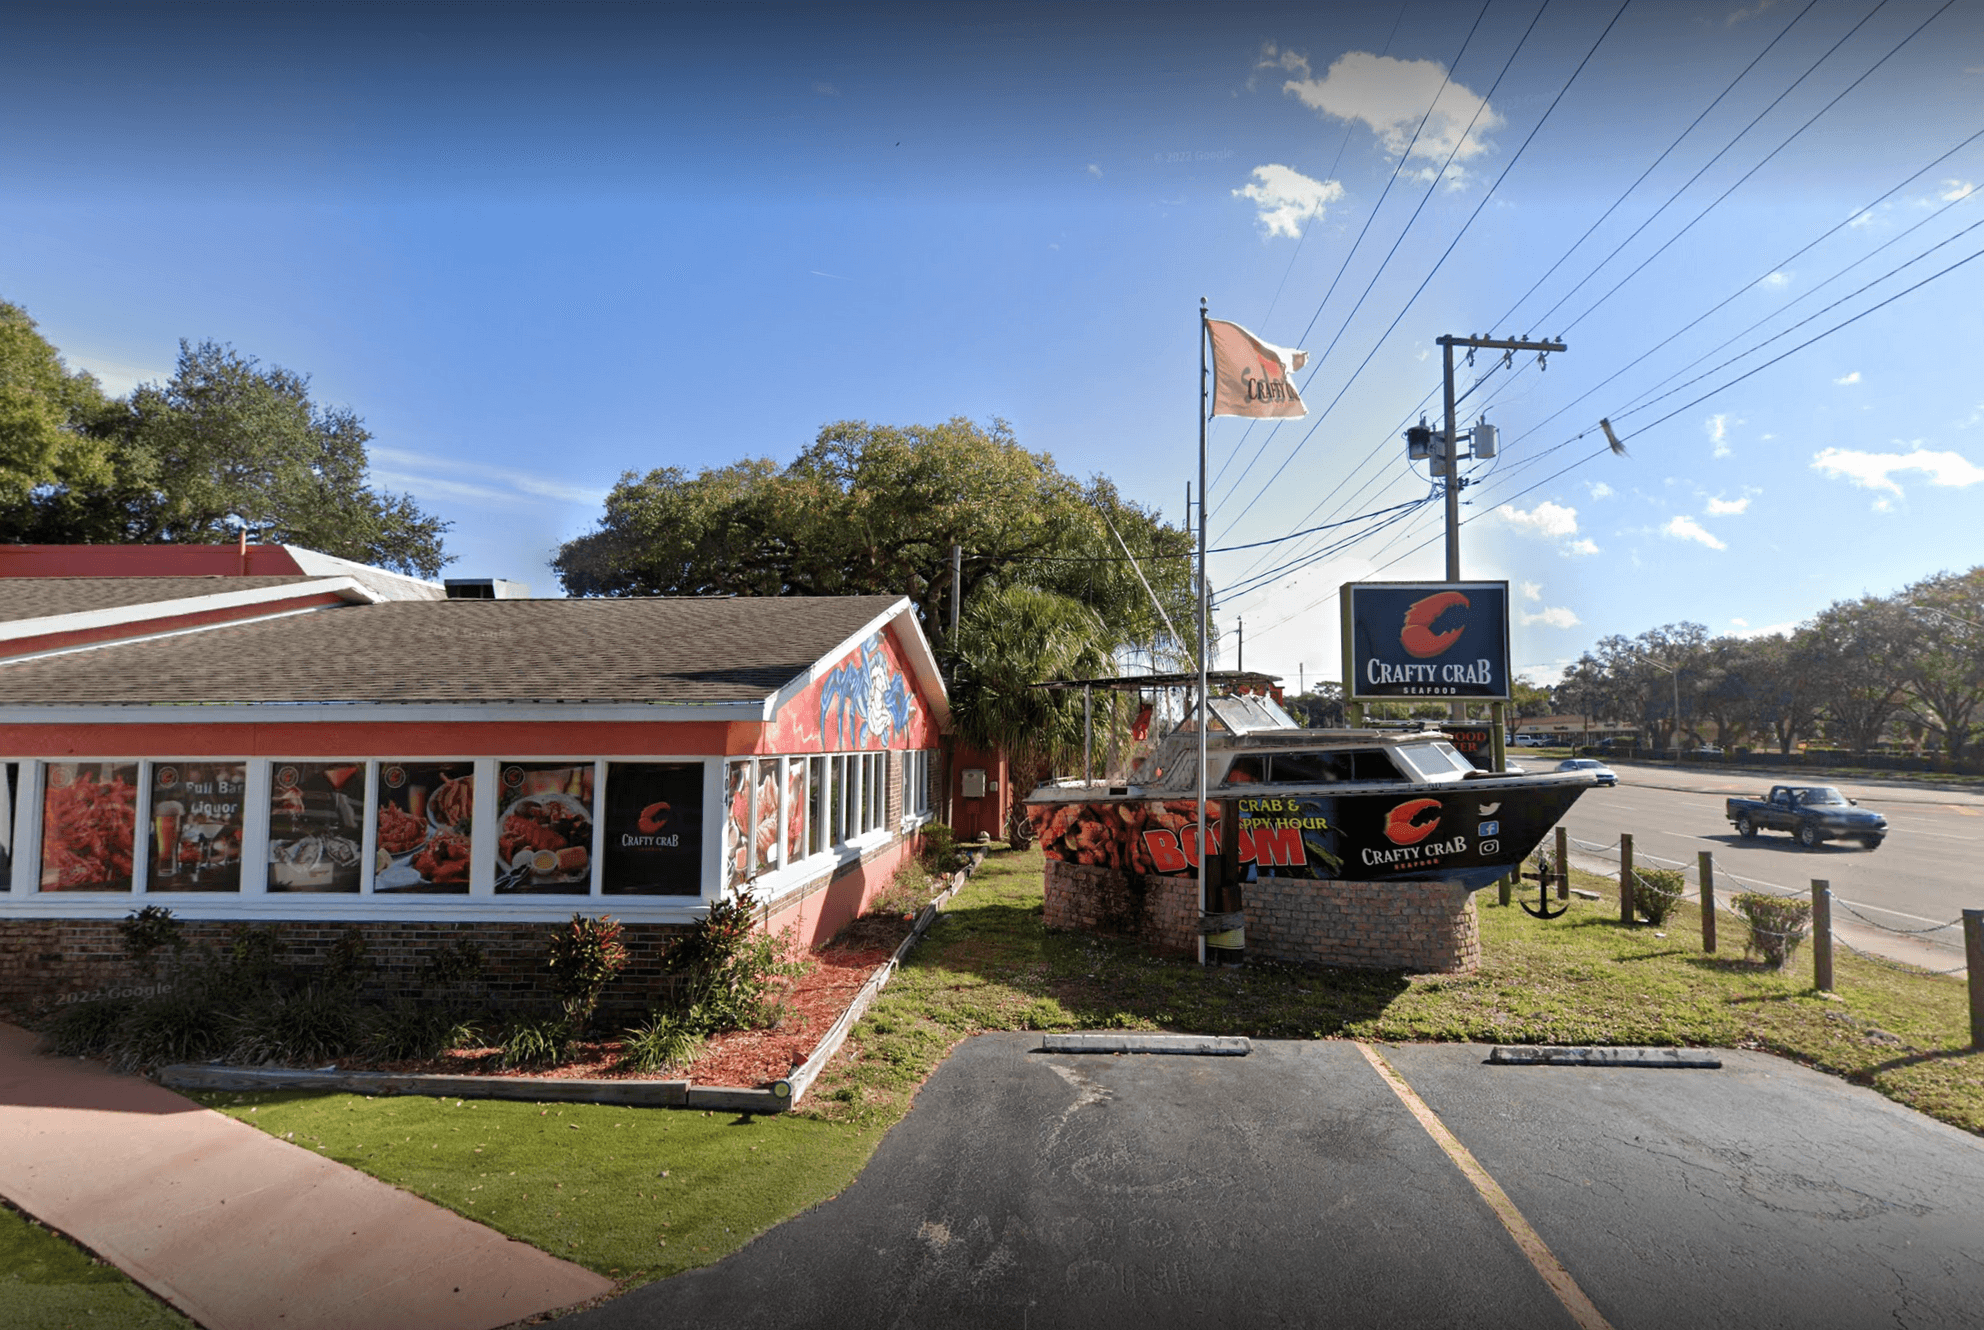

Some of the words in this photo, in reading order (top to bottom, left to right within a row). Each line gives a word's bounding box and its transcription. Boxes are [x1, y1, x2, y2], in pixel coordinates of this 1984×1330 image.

[1366, 657, 1438, 685] CRAFTY
[1441, 658, 1493, 685] CRAB
[1402, 686, 1457, 695] SEAFOOD
[185, 781, 213, 794] Full
[218, 781, 244, 794] Bar
[191, 801, 238, 815] Liquor
[1238, 799, 1283, 812] CRAB
[1287, 799, 1300, 812] &
[1276, 817, 1329, 830] HOUR
[622, 834, 654, 847] CRAFTY
[656, 834, 679, 848] CRAB
[1361, 847, 1421, 867] CRAFTY
[1424, 836, 1468, 857] CRAB
